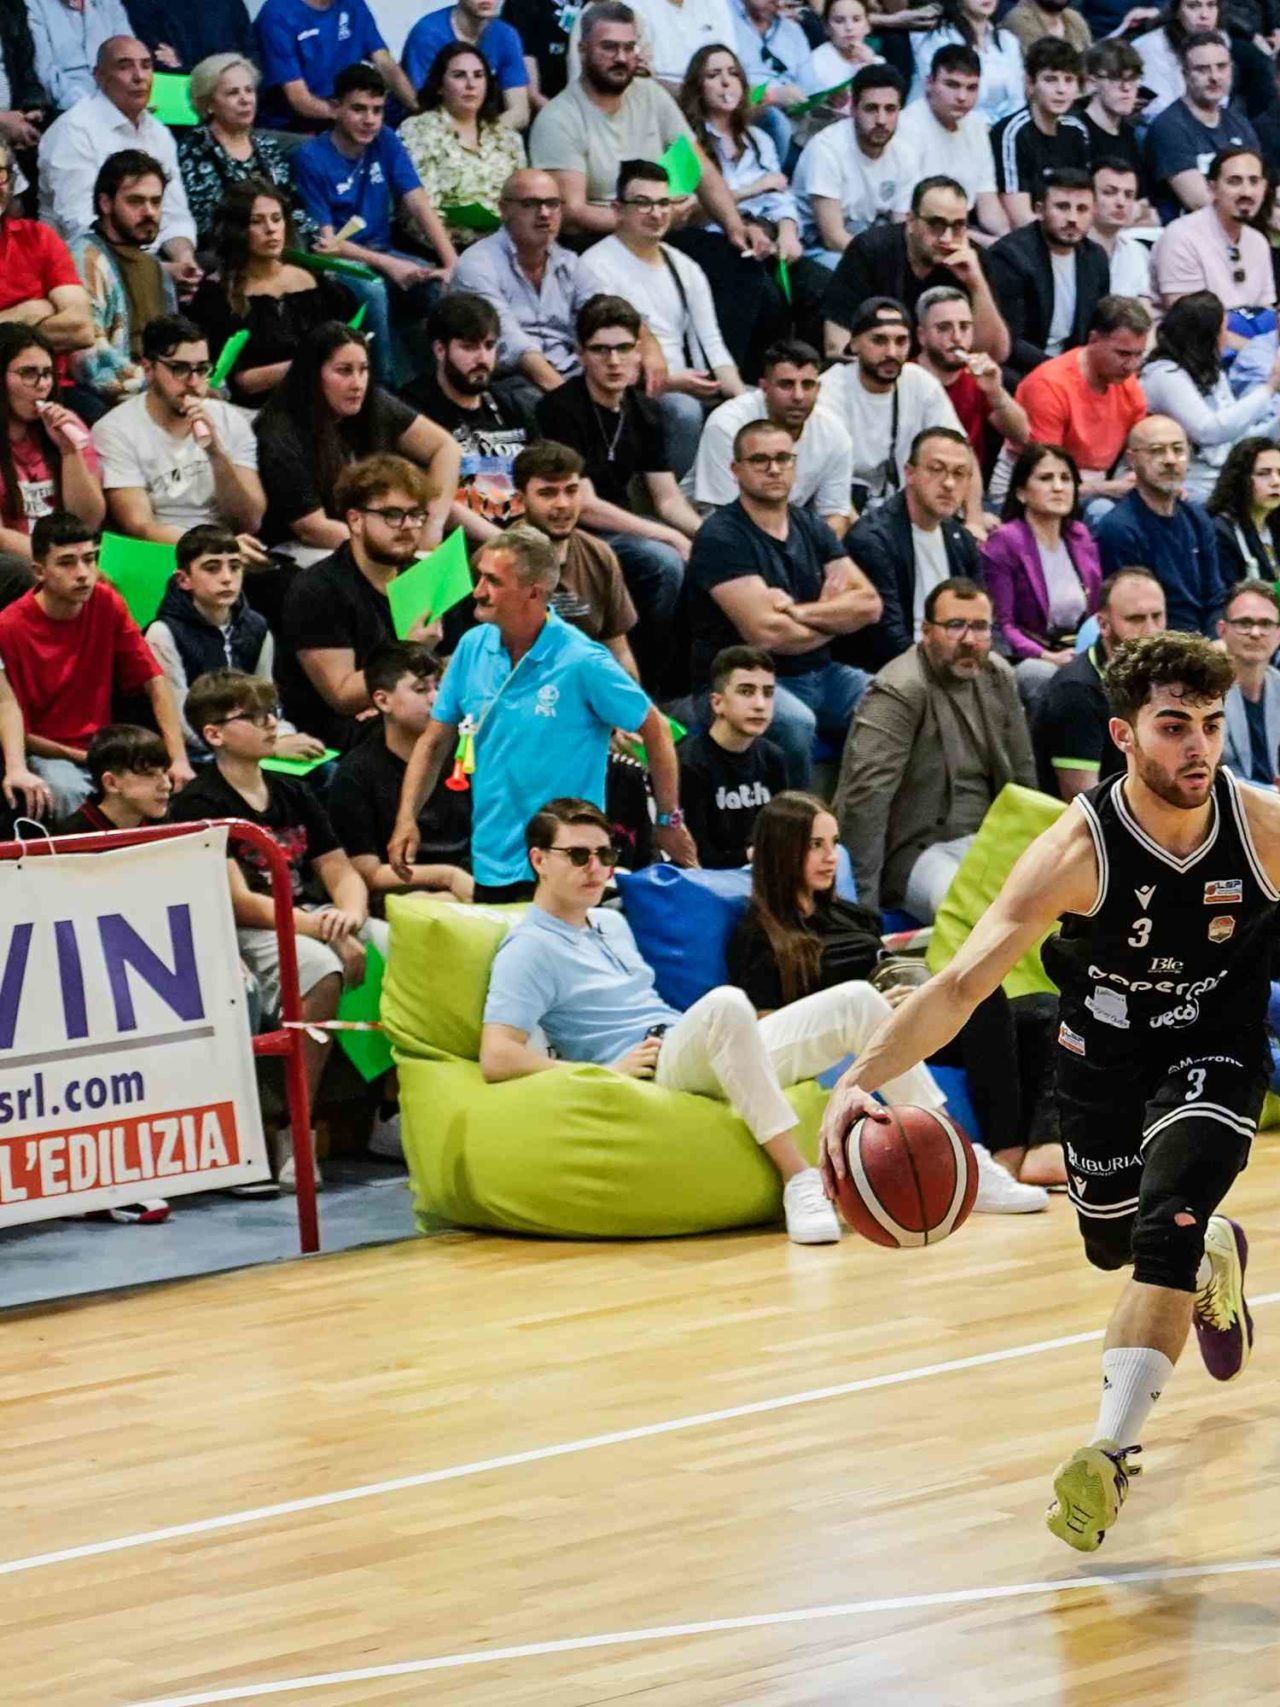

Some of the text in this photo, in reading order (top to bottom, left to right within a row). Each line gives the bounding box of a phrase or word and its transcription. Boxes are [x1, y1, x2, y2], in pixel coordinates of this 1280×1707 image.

[1127, 917, 1153, 948] 3
[1185, 1068, 1207, 1101] 3
[0, 1110, 229, 1202] L'EDILIZIA
[1074, 1153, 1143, 1173] LIBURIA
